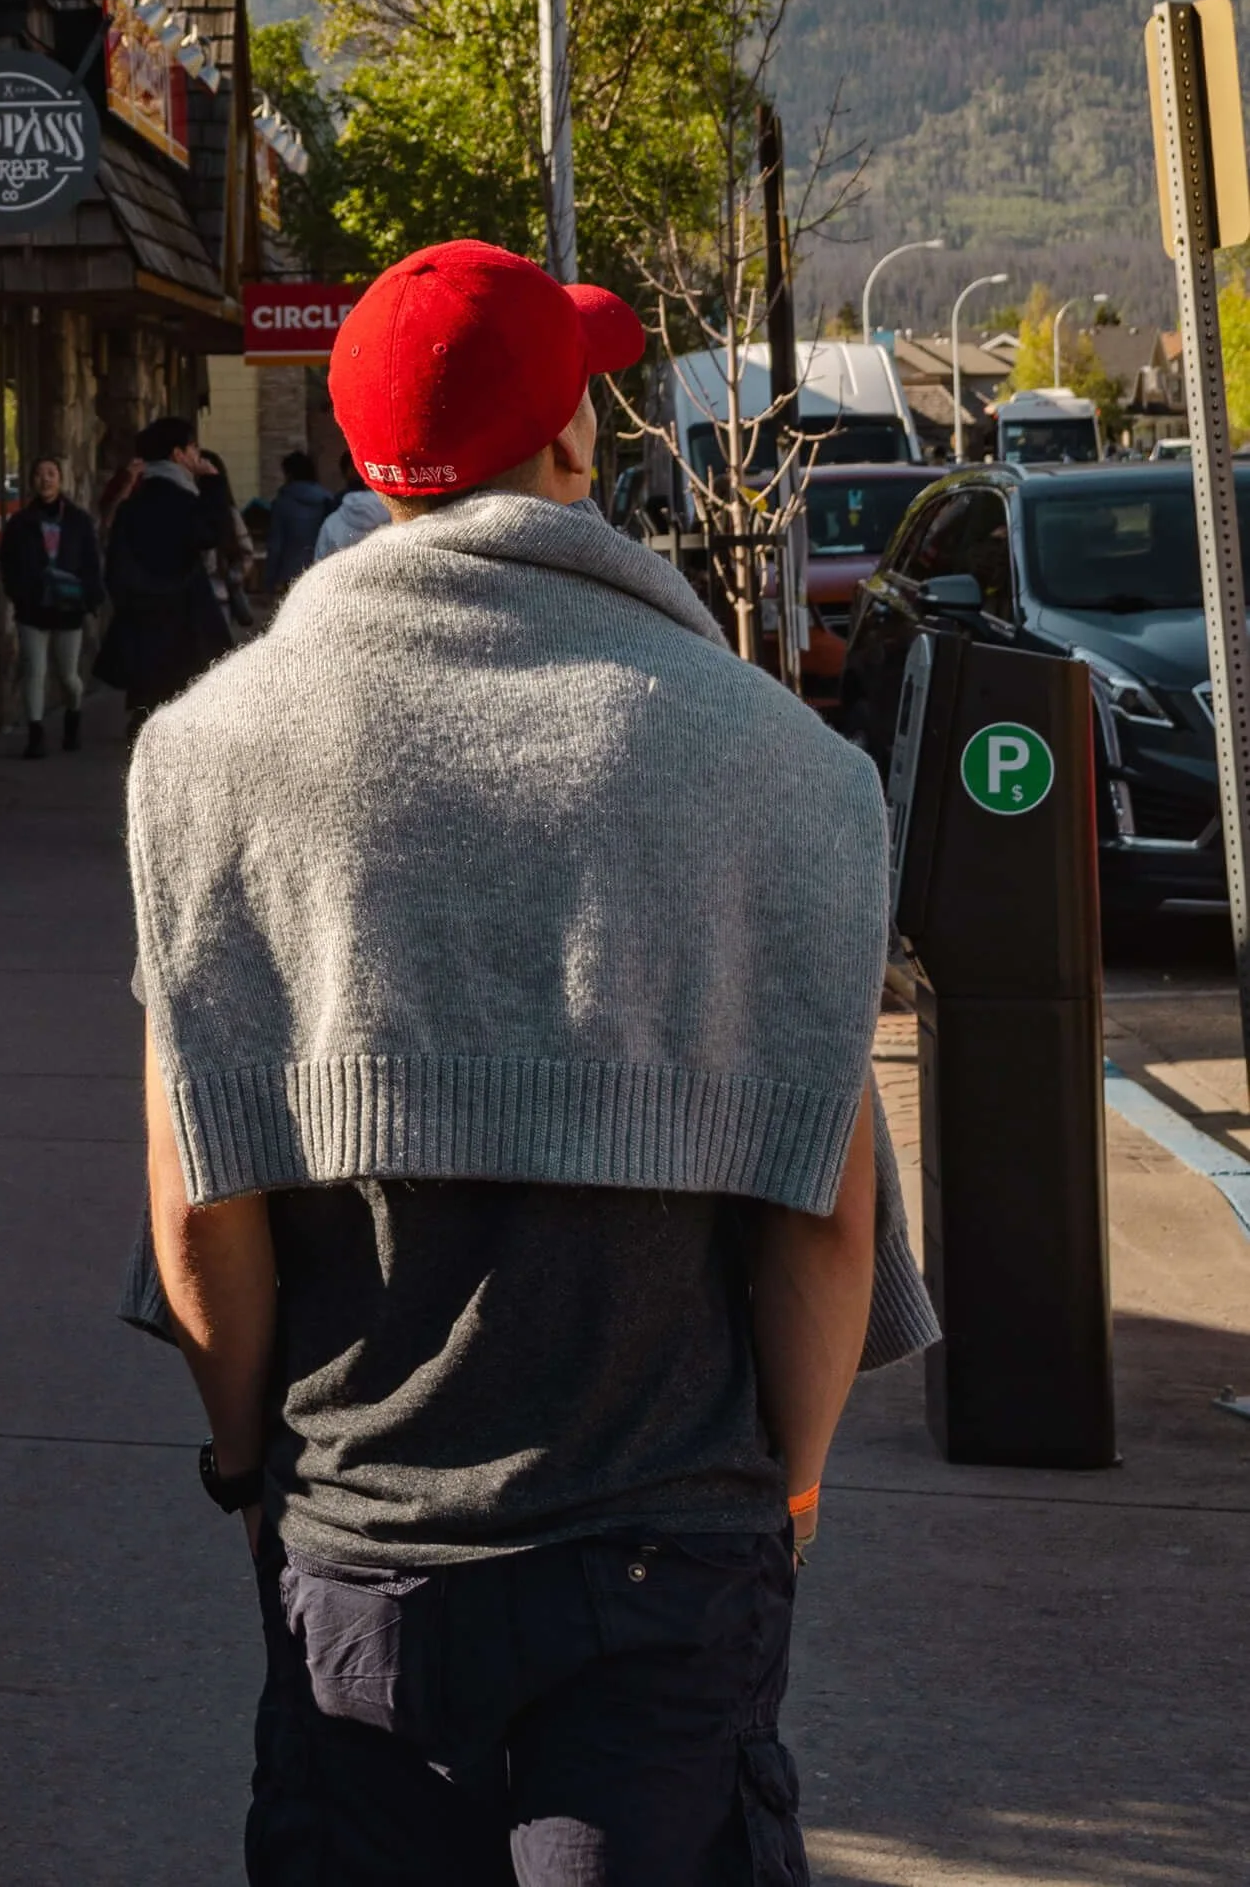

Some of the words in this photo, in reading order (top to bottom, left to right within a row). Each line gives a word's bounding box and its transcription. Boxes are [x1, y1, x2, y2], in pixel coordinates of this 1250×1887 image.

[2, 190, 19, 202] CO
[363, 461, 404, 483] BLUE
[408, 465, 458, 484] JAYS
[988, 735, 1030, 794] P
